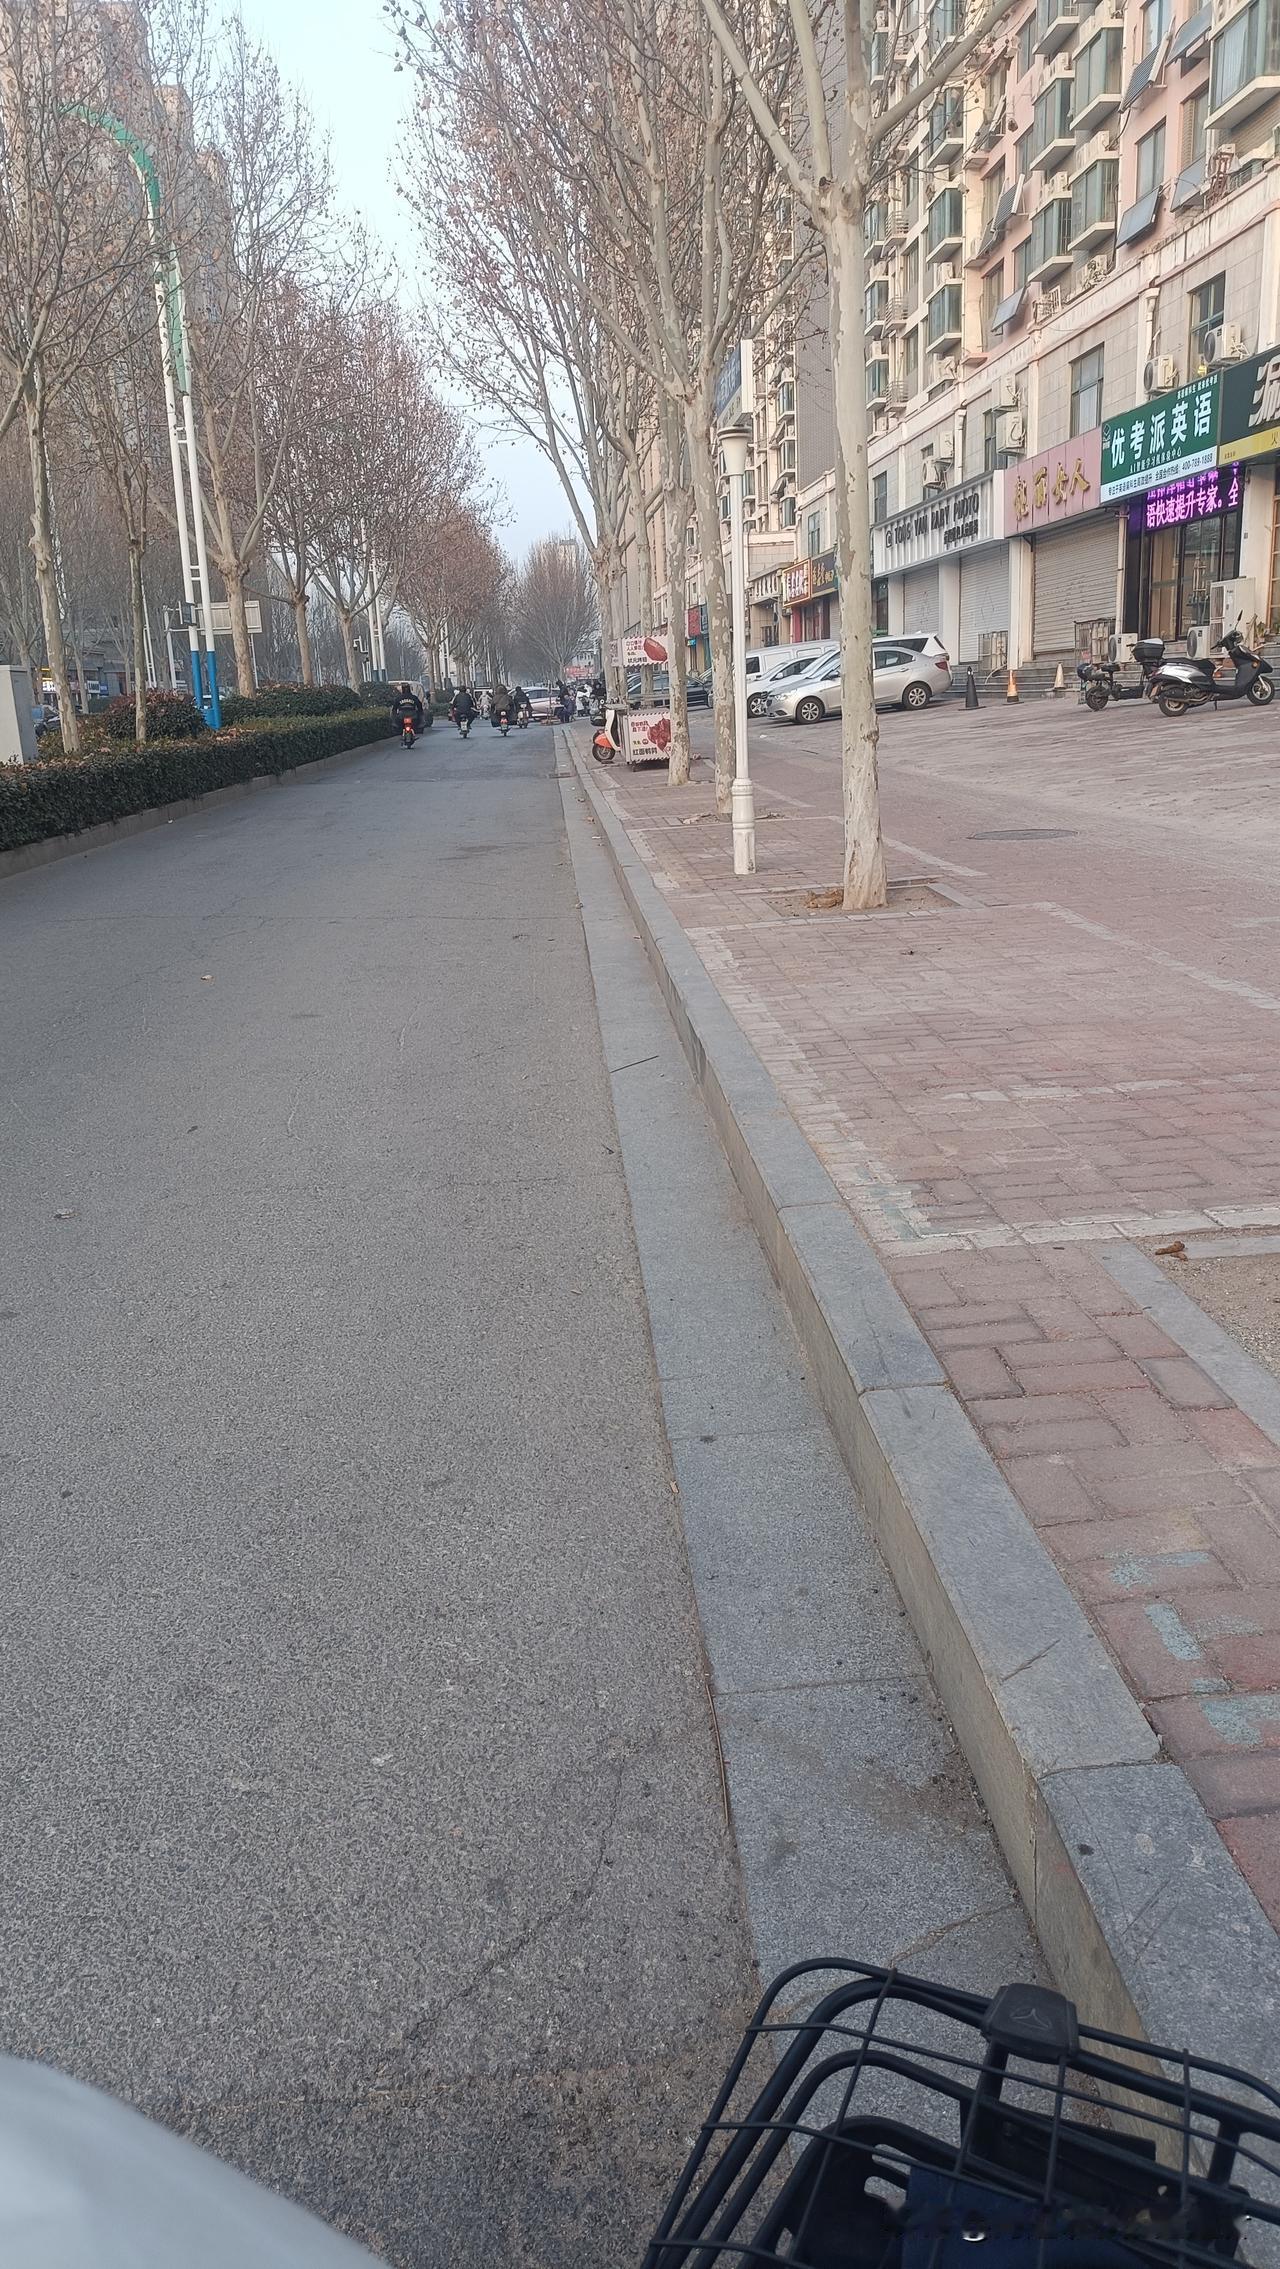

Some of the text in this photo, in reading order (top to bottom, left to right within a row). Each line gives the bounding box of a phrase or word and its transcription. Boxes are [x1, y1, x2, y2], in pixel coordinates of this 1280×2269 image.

[1111, 391, 1212, 468] 优考派英语
[953, 493, 980, 522] PHOTO
